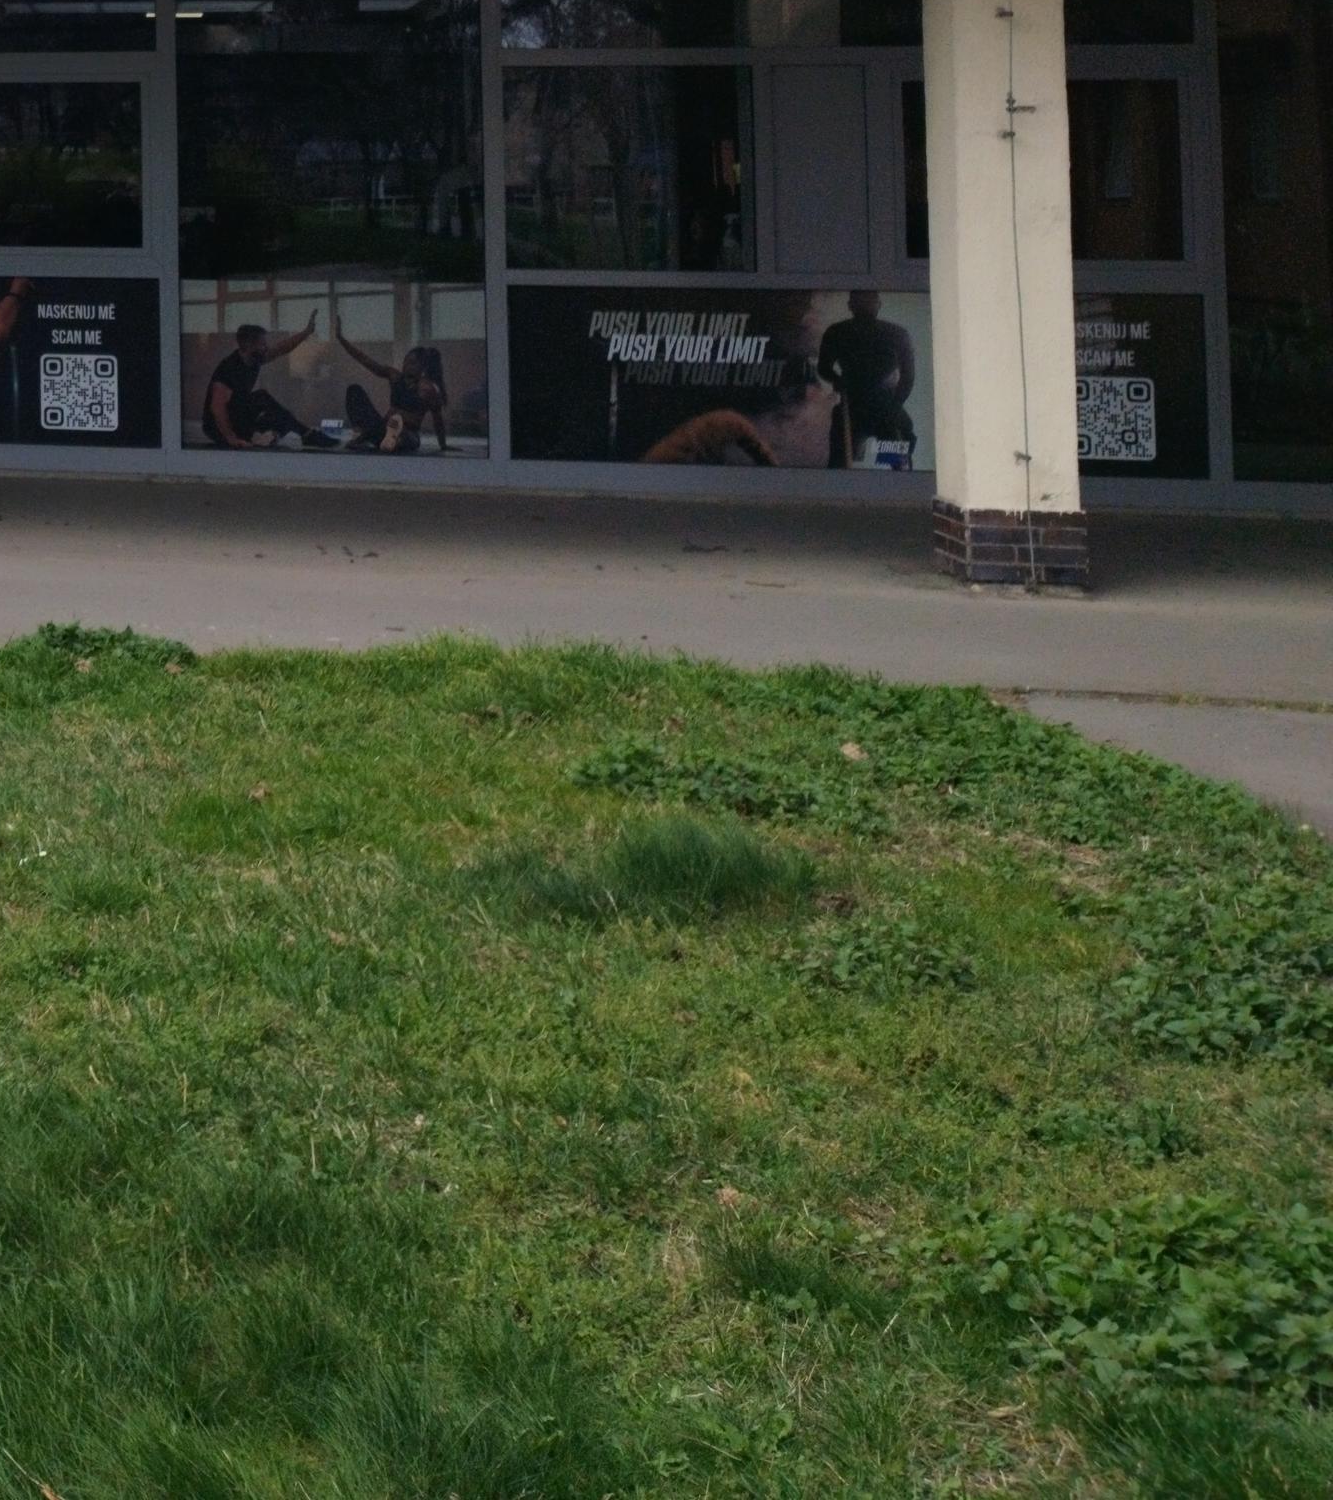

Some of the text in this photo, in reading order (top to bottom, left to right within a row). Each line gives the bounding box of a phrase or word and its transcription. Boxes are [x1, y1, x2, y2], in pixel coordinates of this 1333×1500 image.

[37, 303, 116, 320] NASKENUJ MĚ
[589, 311, 751, 338] PUSH YOUR LIMIT
[1076, 320, 1151, 340] SKENUJ MĚ
[51, 329, 102, 345] SCAN ME
[607, 335, 771, 364] PUSH YOUR LIMIT
[1076, 349, 1136, 367] SCAN ME
[624, 359, 787, 388] PUSH YOUR LIMIT
[874, 441, 910, 453] EORGE'S
